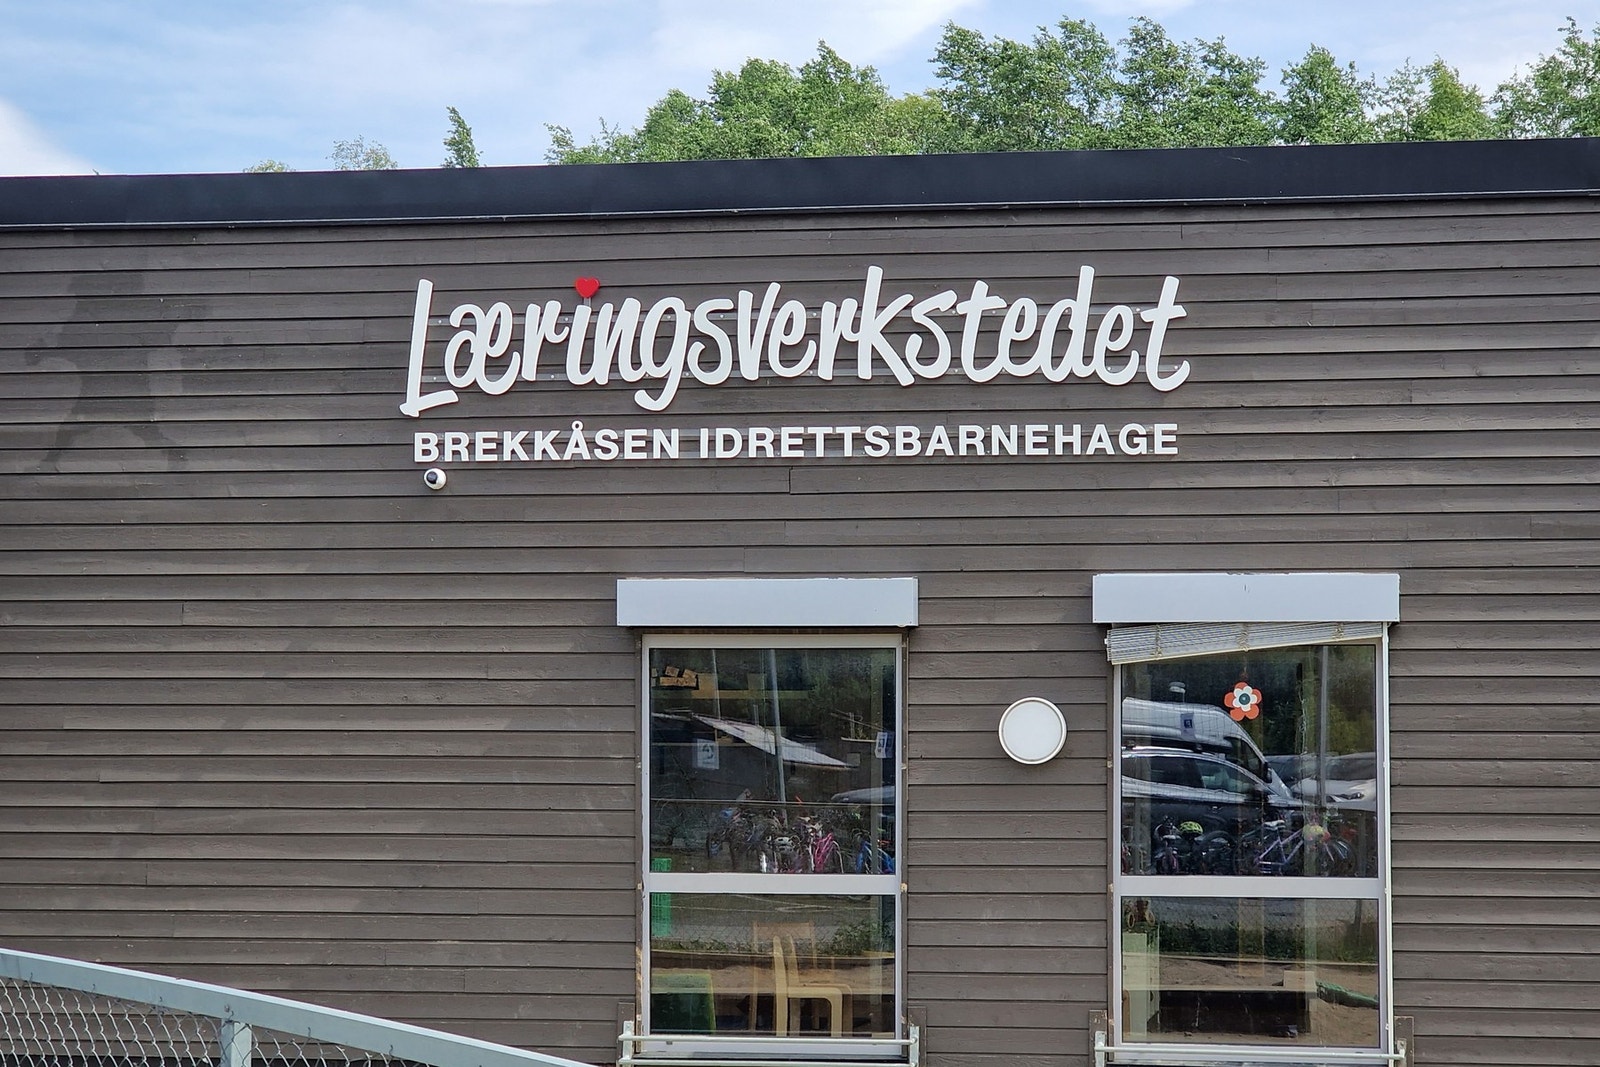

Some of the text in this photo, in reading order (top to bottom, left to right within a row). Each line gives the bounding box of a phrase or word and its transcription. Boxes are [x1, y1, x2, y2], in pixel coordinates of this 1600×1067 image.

[399, 265, 1192, 419] Læringsverkstedet
[413, 420, 1179, 463] BREKKÅSEN IDRETTSBARNEHAGE
